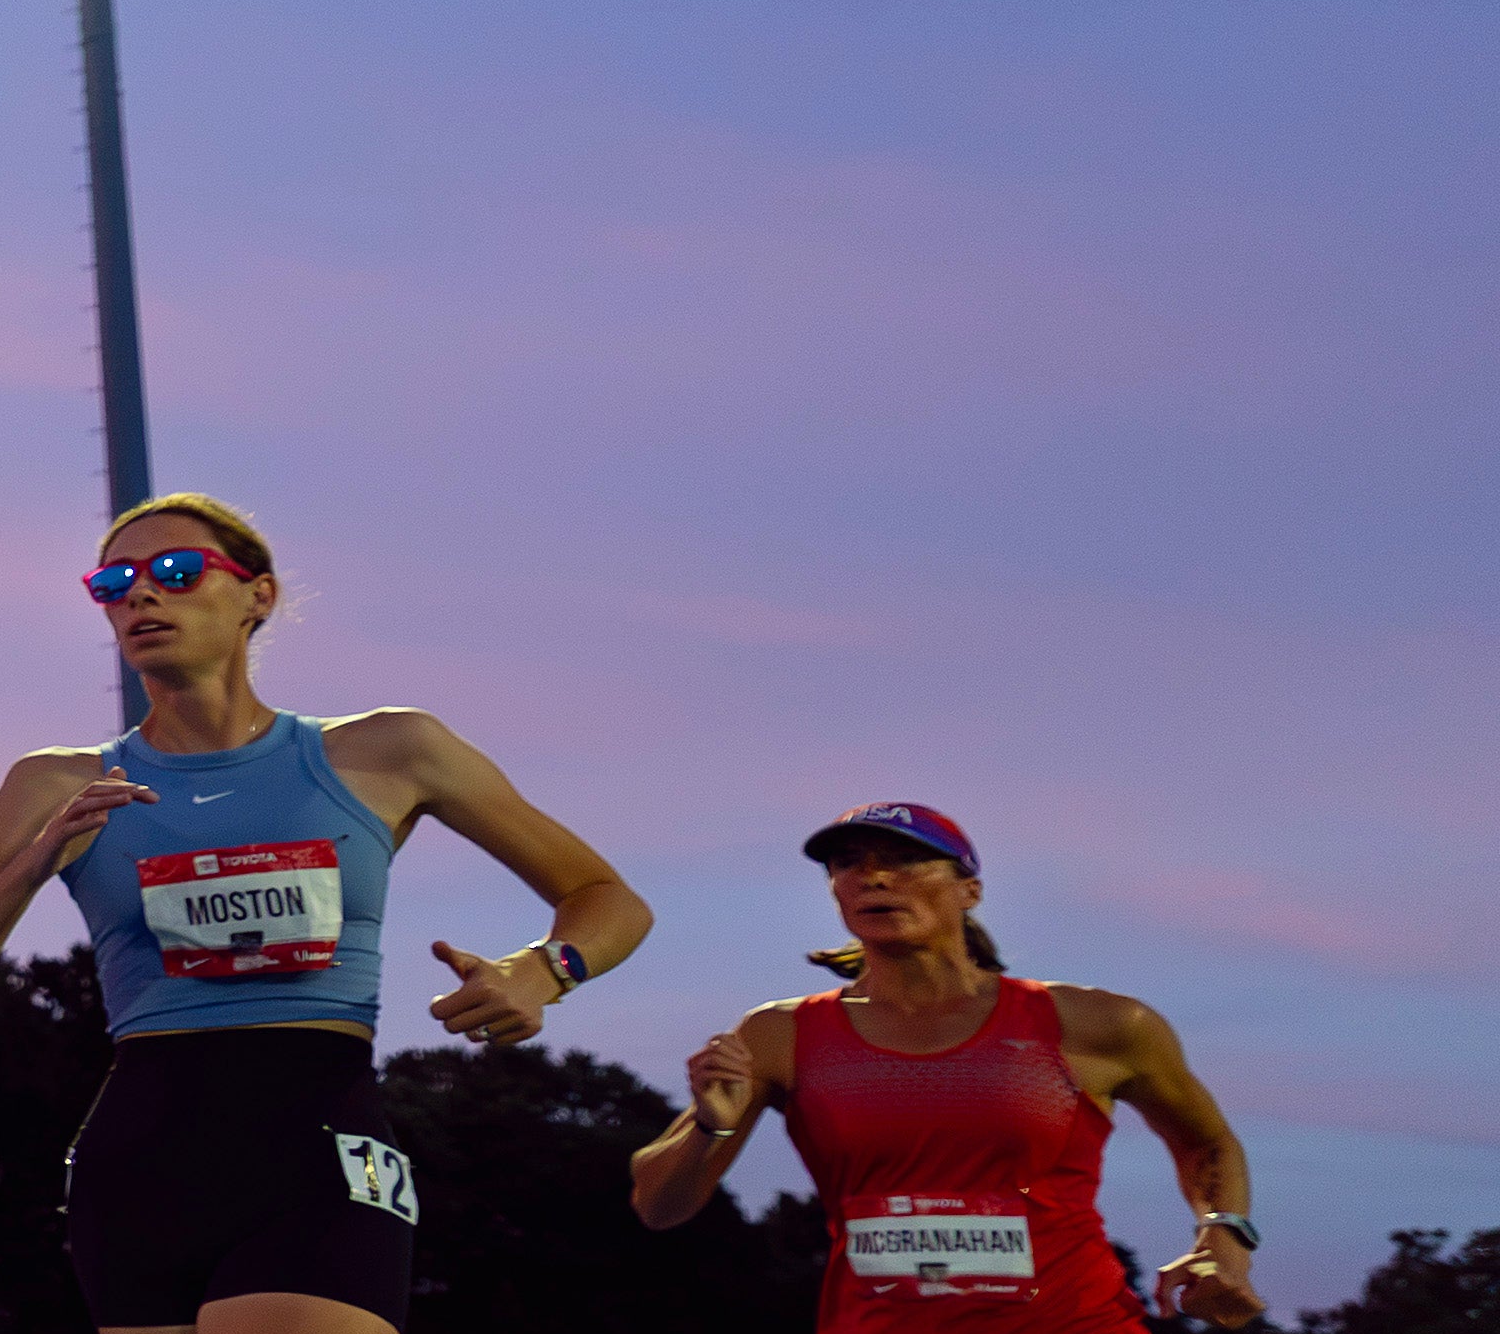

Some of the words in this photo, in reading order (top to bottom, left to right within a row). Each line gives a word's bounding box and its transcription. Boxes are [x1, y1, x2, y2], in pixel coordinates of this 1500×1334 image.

[221, 852, 278, 866] TOYOTA
[185, 885, 306, 926] MOSTON
[348, 1140, 411, 1218] 12
[855, 1229, 1025, 1255] MCGRANAHAN
